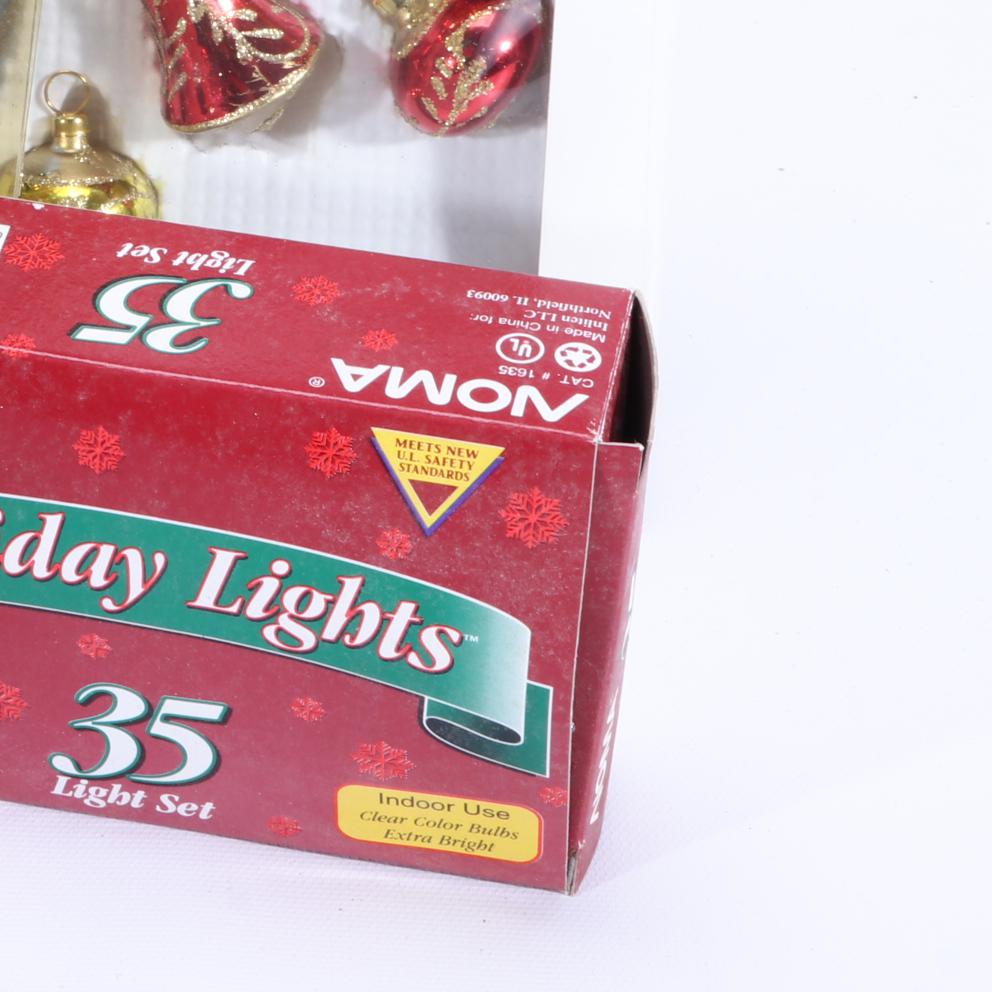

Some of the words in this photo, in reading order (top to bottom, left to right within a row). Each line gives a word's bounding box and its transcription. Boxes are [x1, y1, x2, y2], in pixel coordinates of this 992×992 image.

[116, 242, 168, 264] Set
[172, 250, 256, 276] Light
[466, 289, 509, 303] 60093
[70, 274, 254, 355] 35
[523, 309, 557, 322] LLC
[533, 298, 612, 320] Northfield,
[497, 317, 541, 332] China
[546, 323, 560, 334] in
[561, 313, 609, 329] Inliten
[564, 326, 606, 343] Made
[498, 364, 535, 379] 1635
[541, 371, 551, 381] #
[557, 373, 595, 388] CAT.
[395, 438, 442, 454] MEETS
[446, 445, 480, 460] NEW
[396, 450, 421, 463] U.L.
[424, 454, 476, 471] SAFETY
[398, 462, 471, 482] STANDARDS
[48, 682, 232, 786] 35
[51, 775, 147, 809] Light
[155, 793, 216, 820] Set
[378, 792, 455, 812] Indoor
[463, 802, 511, 821] Use
[359, 810, 409, 826] Clear
[414, 816, 464, 832] Color
[468, 823, 520, 841] Bulbs
[383, 828, 433, 844] Extra
[438, 834, 496, 853] Bright
